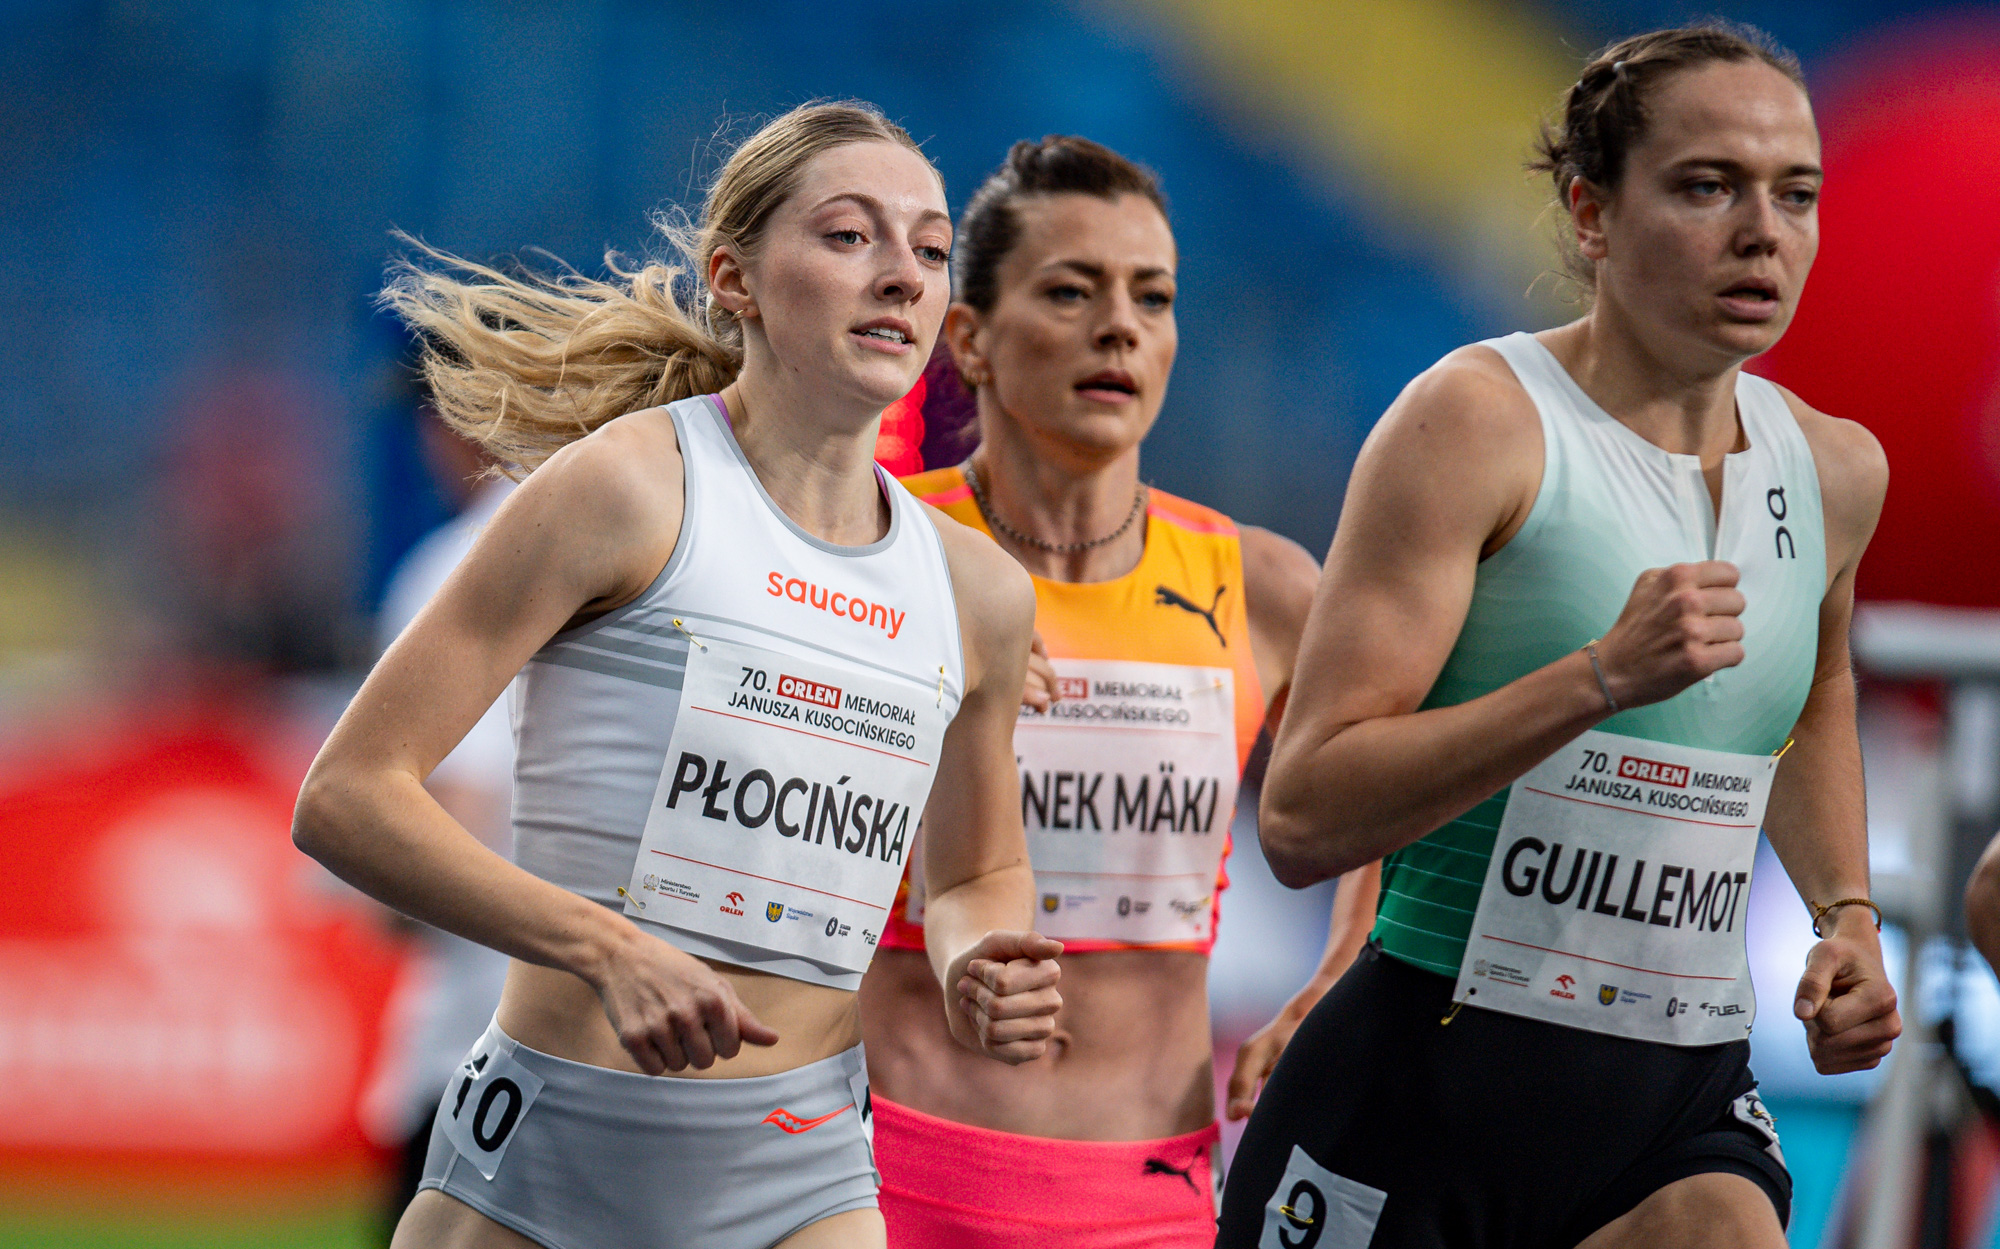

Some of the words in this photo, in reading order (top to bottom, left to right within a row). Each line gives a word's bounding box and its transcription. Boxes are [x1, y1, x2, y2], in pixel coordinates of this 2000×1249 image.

[766, 571, 906, 640] saucony
[728, 691, 800, 722] JANUSZA
[804, 708, 916, 751] KUSOCIŃSKIEGO
[739, 666, 772, 693] 70.
[780, 678, 839, 705] ORLEN
[844, 693, 916, 727] MEMORIAŁ
[1112, 761, 1220, 834] MÄKI
[1565, 774, 1643, 803] JANUSZA
[1647, 789, 1751, 818] KUSOCIŃSKIEGO
[1579, 750, 1613, 775] 70.
[1620, 758, 1688, 786] ORLEN
[665, 750, 911, 866] PŁOCIŃSKA
[719, 905, 745, 917] ORLEN
[1502, 836, 1748, 933] GUILLEMOT
[452, 1051, 523, 1153] 10
[1278, 1179, 1328, 1249] 9
